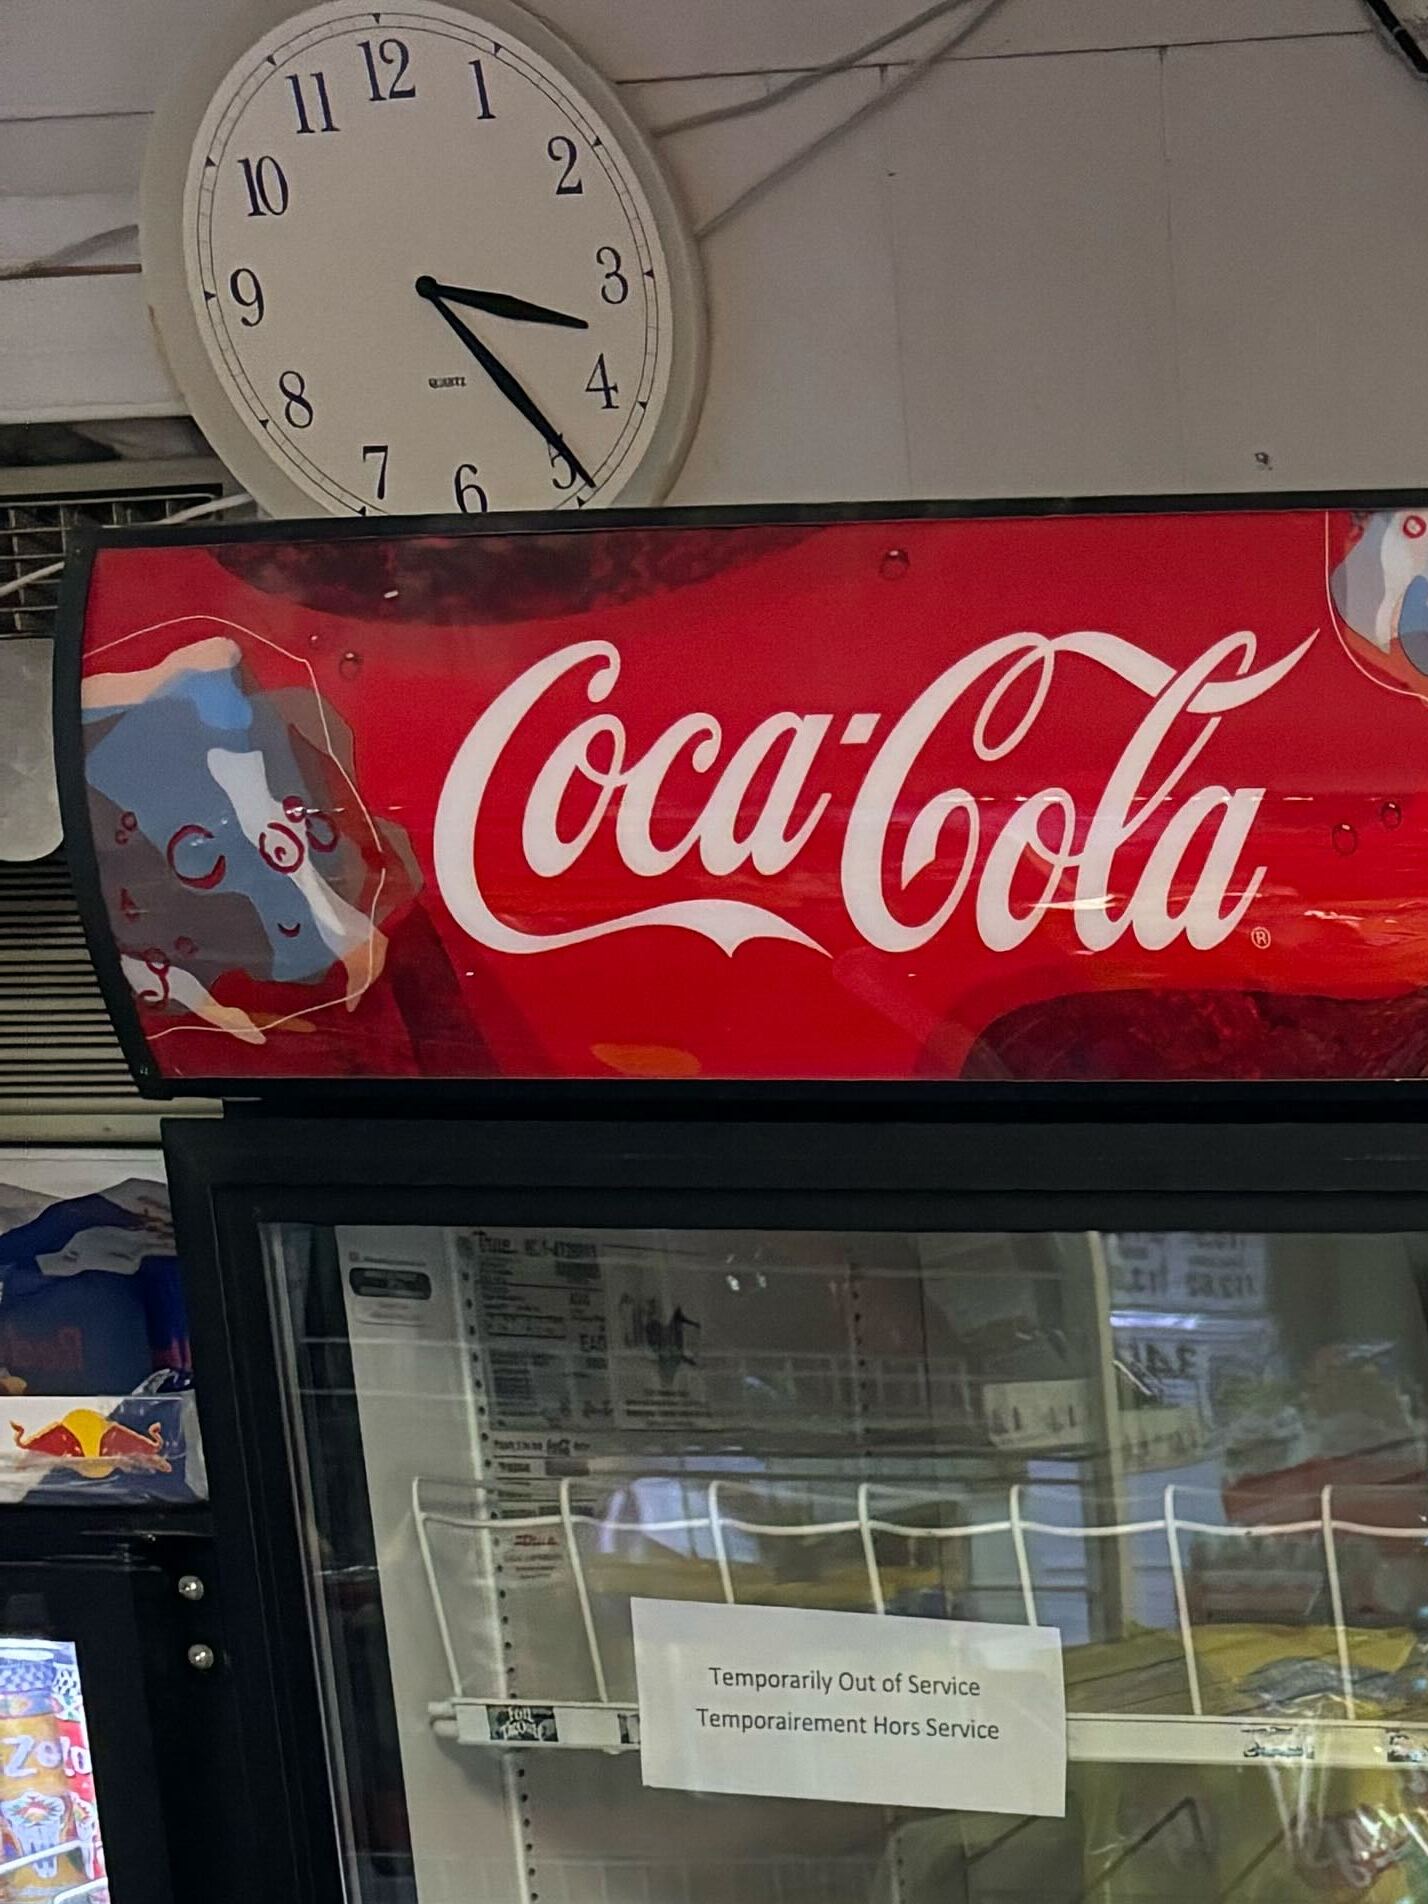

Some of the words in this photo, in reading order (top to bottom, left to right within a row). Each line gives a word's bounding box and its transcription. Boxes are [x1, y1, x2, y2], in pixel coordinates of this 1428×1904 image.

[357, 38, 416, 102] 12
[469, 60, 497, 121] 1
[286, 72, 340, 134] 11
[238, 156, 290, 218] 10
[548, 137, 584, 196] 2
[230, 268, 266, 327] 9
[596, 246, 628, 304] 3
[279, 371, 314, 429] 8
[586, 353, 620, 410] 4
[361, 445, 390, 501] 7
[434, 629, 1320, 958] Coca-Cola
[709, 1666, 834, 1698] Temporarily
[838, 1670, 876, 1693] Out
[881, 1669, 905, 1694] of
[908, 1673, 982, 1698] Service
[697, 1707, 868, 1741] Temporairement
[873, 1711, 919, 1737] Hors
[922, 1715, 1001, 1742] Service
